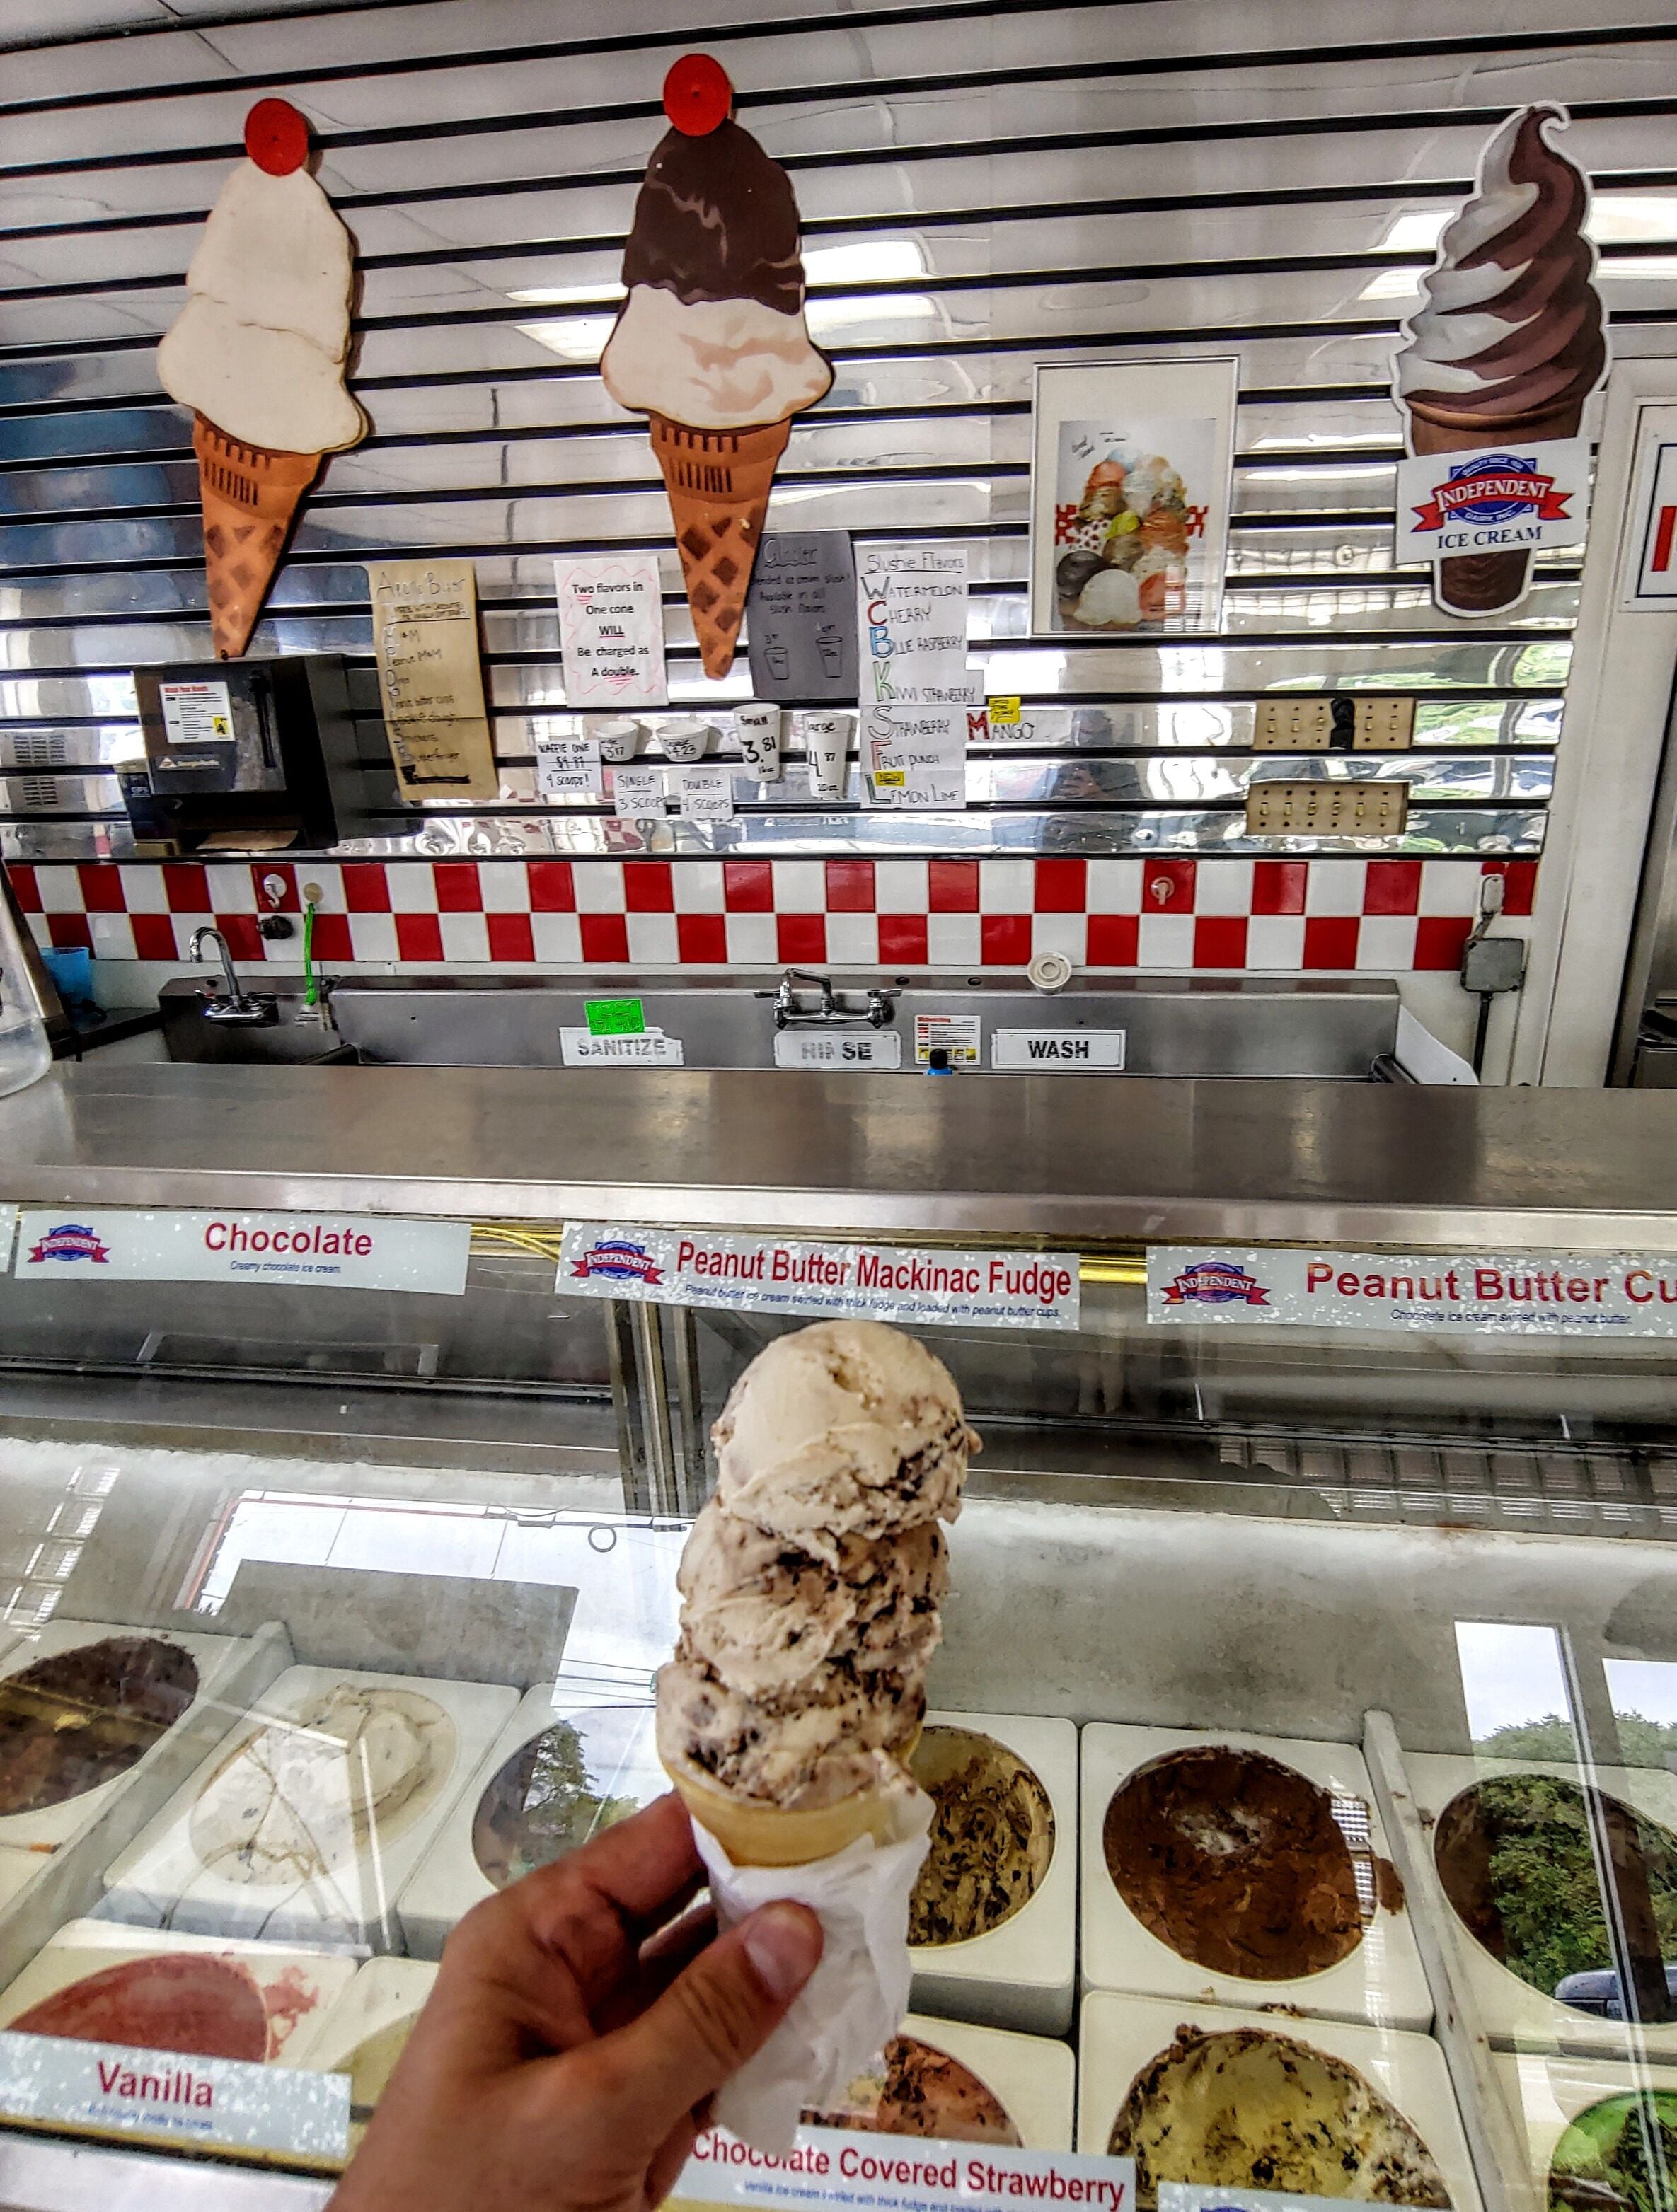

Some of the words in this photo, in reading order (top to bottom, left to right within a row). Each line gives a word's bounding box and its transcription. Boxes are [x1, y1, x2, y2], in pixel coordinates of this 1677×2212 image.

[1434, 479, 1551, 513] INDEPENDENT
[1437, 534, 1469, 549] ICE
[1474, 526, 1543, 546] CREAM
[572, 584, 594, 594] Two
[597, 582, 631, 593] flavors
[633, 581, 644, 591] in
[585, 606, 607, 615] One
[609, 606, 634, 614] cone
[867, 600, 933, 626] CHERRY
[599, 625, 625, 635] WILL
[577, 647, 592, 656] Be
[596, 645, 635, 658] charged
[638, 647, 650, 655] as
[591, 668, 599, 676] A
[601, 666, 640, 677] double.
[966, 710, 1035, 741] MANGO
[617, 775, 656, 788] SINGLE
[682, 778, 725, 791] DOUBLE
[618, 798, 629, 811] 3
[681, 797, 691, 812] 4
[577, 1038, 667, 1056] SANITIZE
[1027, 1040, 1090, 1060] WASH
[204, 1222, 373, 1257] Chocolate
[230, 1260, 261, 1273] Creamy
[262, 1261, 299, 1272] chocolate
[301, 1263, 313, 1273] ice
[676, 1240, 766, 1281] Peanut
[771, 1249, 851, 1286] Butter
[856, 1254, 980, 1294] Mackinac
[988, 1261, 1071, 1305] Fudge
[1306, 1262, 1461, 1302] Peanut
[1474, 1268, 1609, 1302] Butter
[1624, 1269, 1677, 1304] Cu
[685, 1284, 715, 1297] Peanut
[761, 1294, 790, 1302] cream
[824, 1297, 844, 1307] with
[868, 1299, 895, 1312] fudge
[897, 1302, 916, 1311] and
[917, 1302, 950, 1314] loaded
[951, 1304, 970, 1314] with
[972, 1304, 1005, 1318] peanut
[1006, 1305, 1035, 1316] butter
[1390, 1309, 1446, 1322] Chocolate
[1447, 1311, 1463, 1322] ice
[1465, 1313, 1497, 1323] cream
[1499, 1312, 1535, 1324] swirled
[1561, 1314, 1598, 1325] peanut
[96, 2059, 214, 2109] Vanilla
[839, 2146, 957, 2189] Covered
[967, 2160, 1126, 2211] Strawberry
